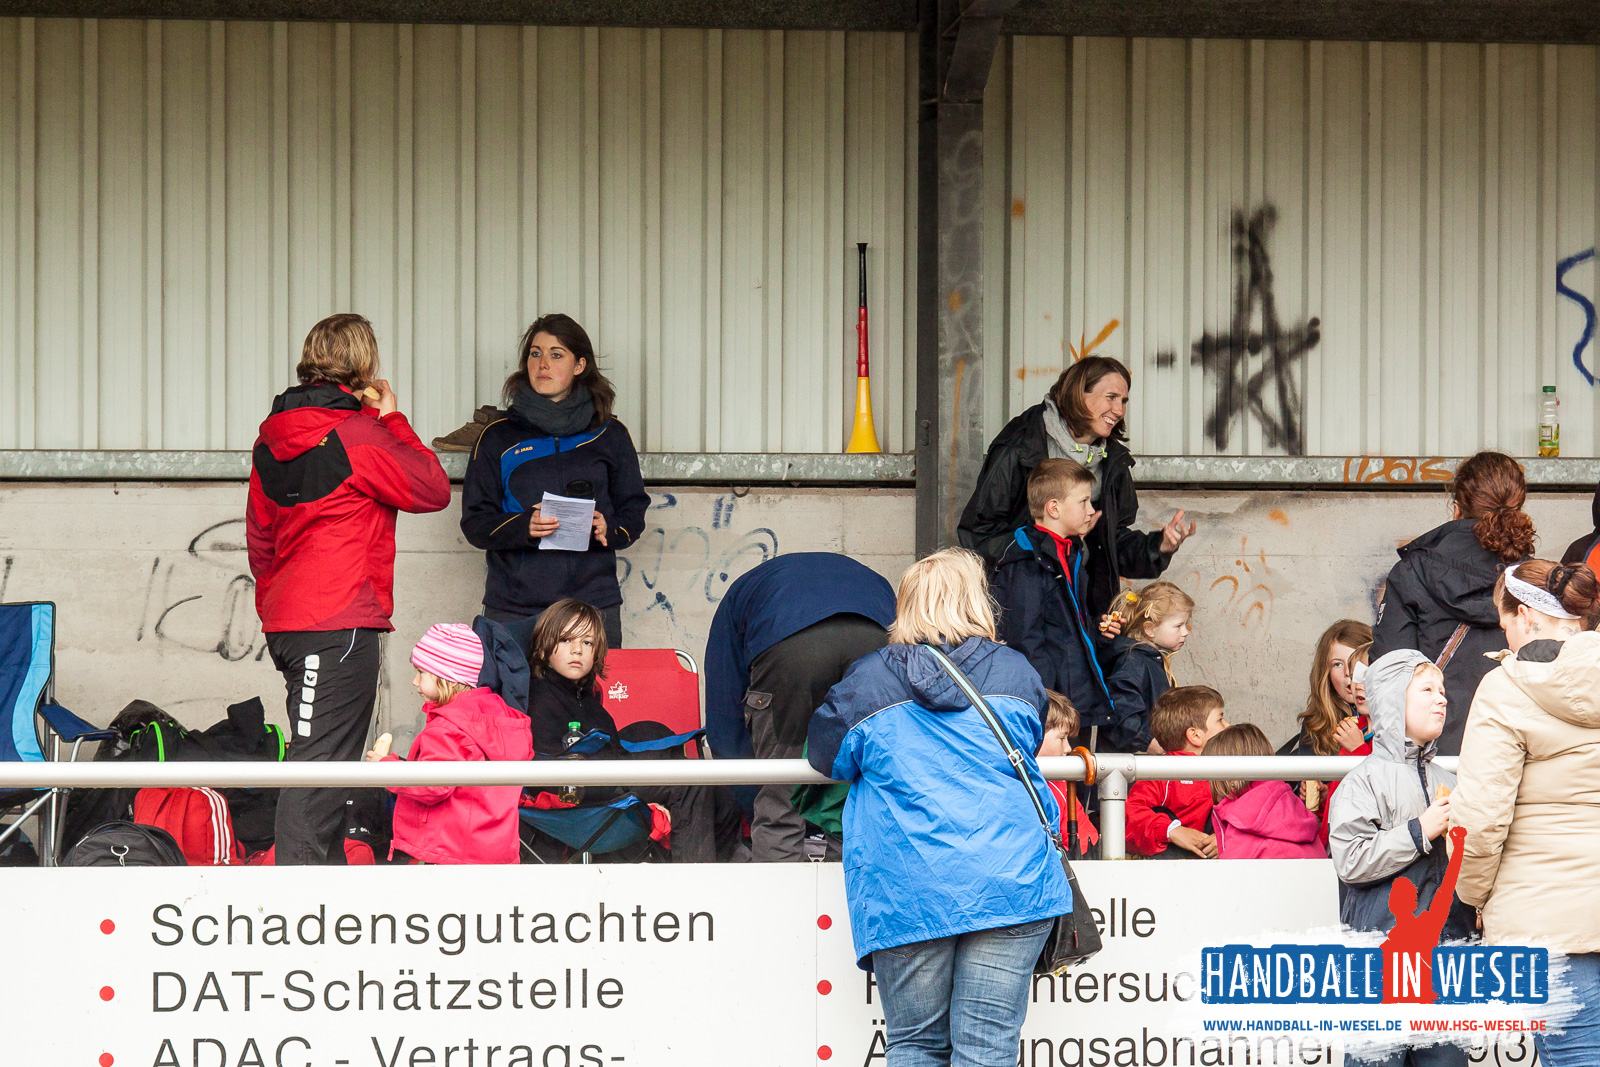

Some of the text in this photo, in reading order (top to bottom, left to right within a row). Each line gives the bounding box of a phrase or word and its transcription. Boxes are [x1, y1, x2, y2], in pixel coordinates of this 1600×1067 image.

[151, 902, 714, 956] Schadensgutachten
[152, 968, 624, 1013] DAT-Schätzstelle
[152, 1036, 312, 1067] ADAC
[370, 1036, 625, 1067] Vertrags-
